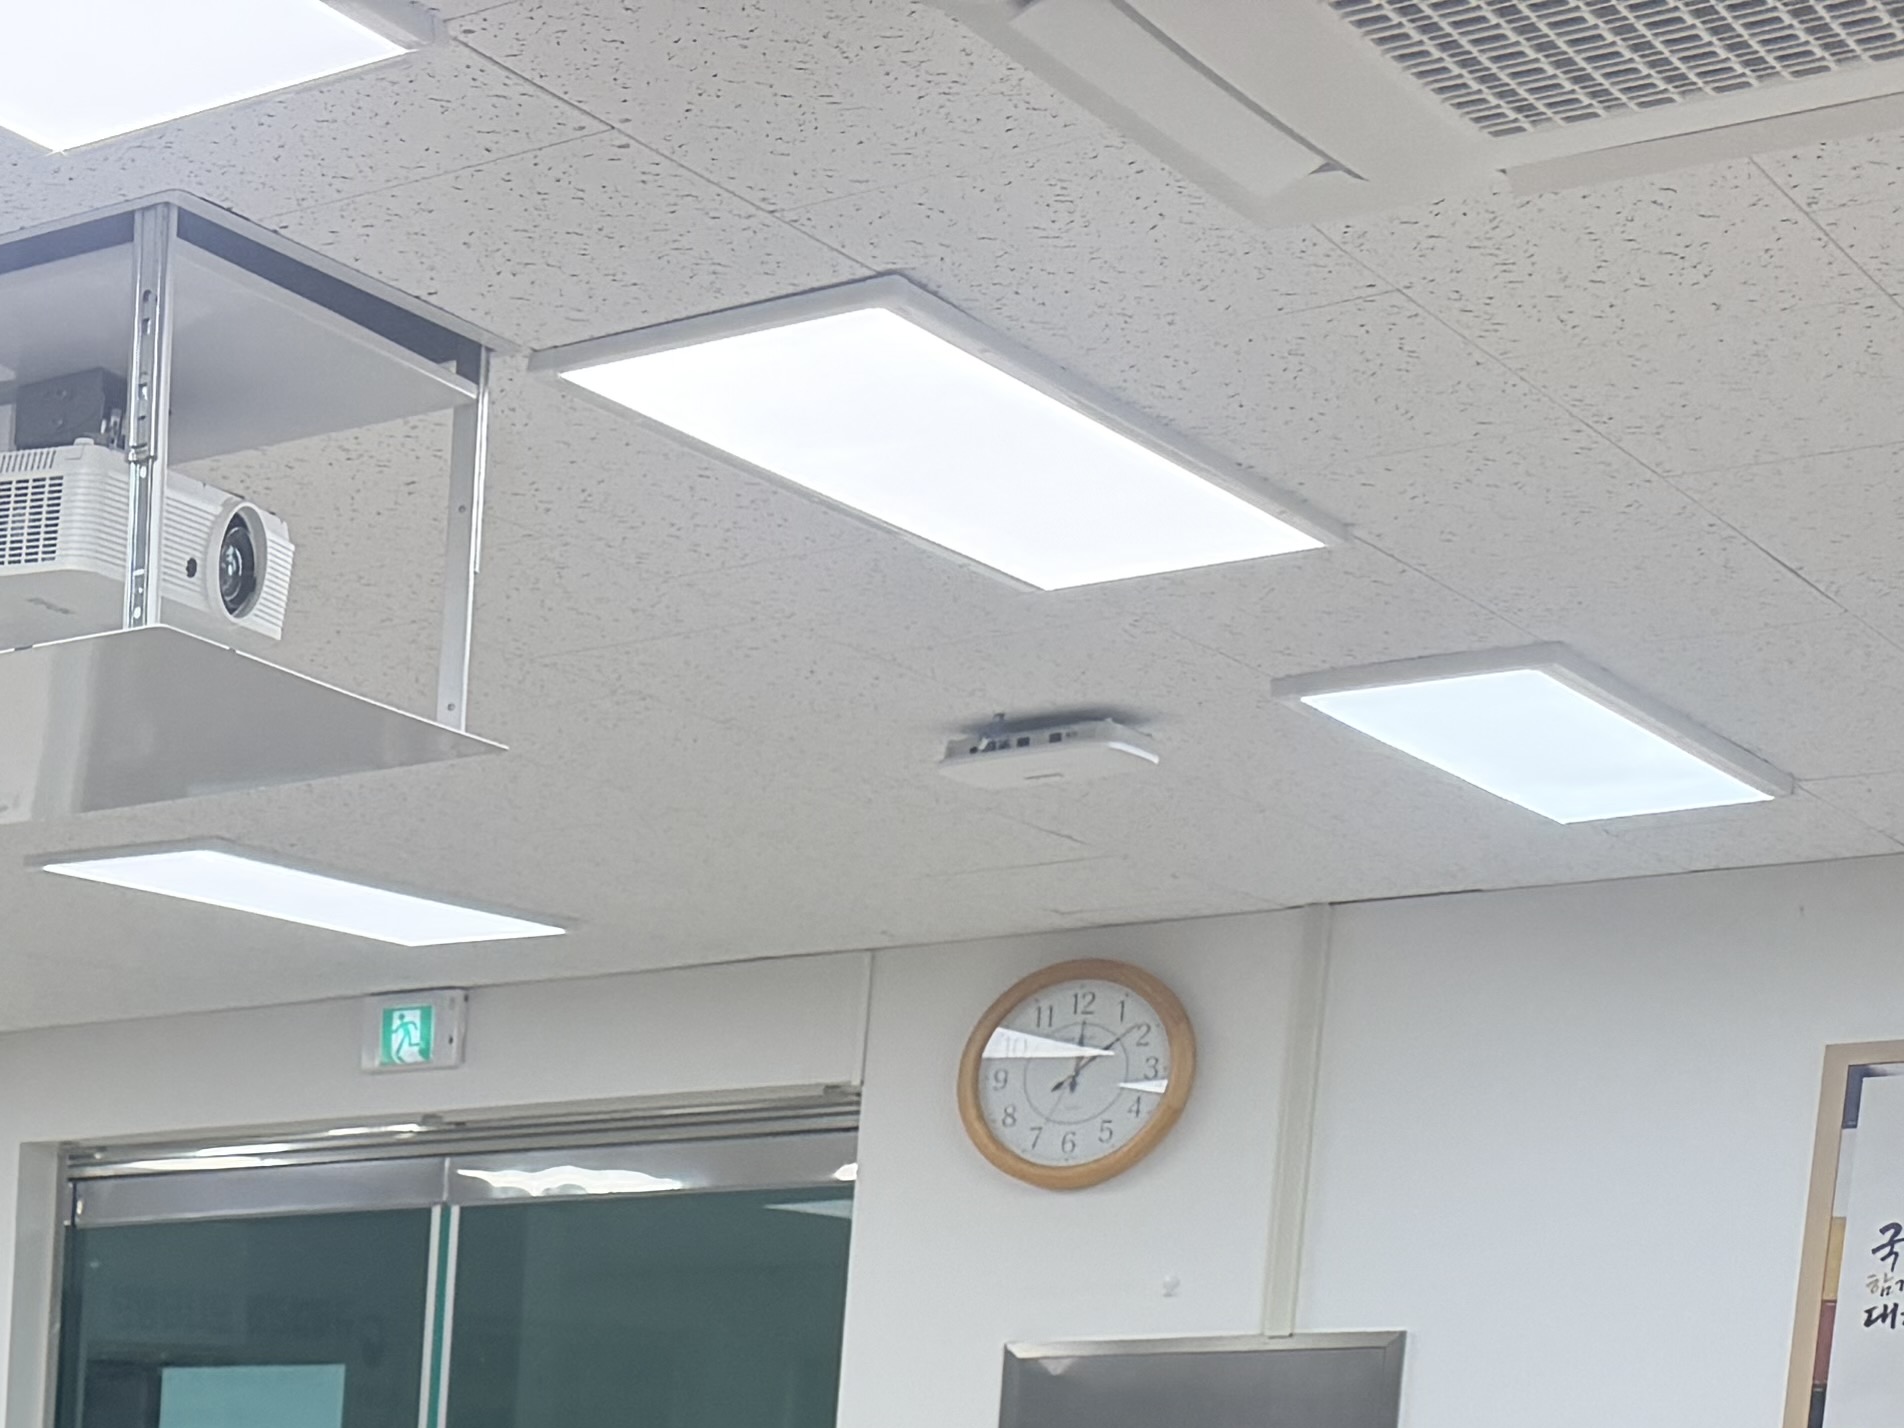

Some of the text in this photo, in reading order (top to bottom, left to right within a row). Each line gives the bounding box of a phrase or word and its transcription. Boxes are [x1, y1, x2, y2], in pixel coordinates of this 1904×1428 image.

[1073, 992, 1096, 1015] 12
[1036, 1005, 1053, 1027] 11
[1136, 1023, 1151, 1047] 2
[993, 1068, 1008, 1091] 9
[1144, 1057, 1159, 1080] 3
[1002, 1104, 1016, 1127] 8
[1128, 1096, 1141, 1117] 4
[1030, 1127, 1042, 1149] 7
[1062, 1131, 1075, 1153] 6
[1098, 1120, 1113, 1143] 5
